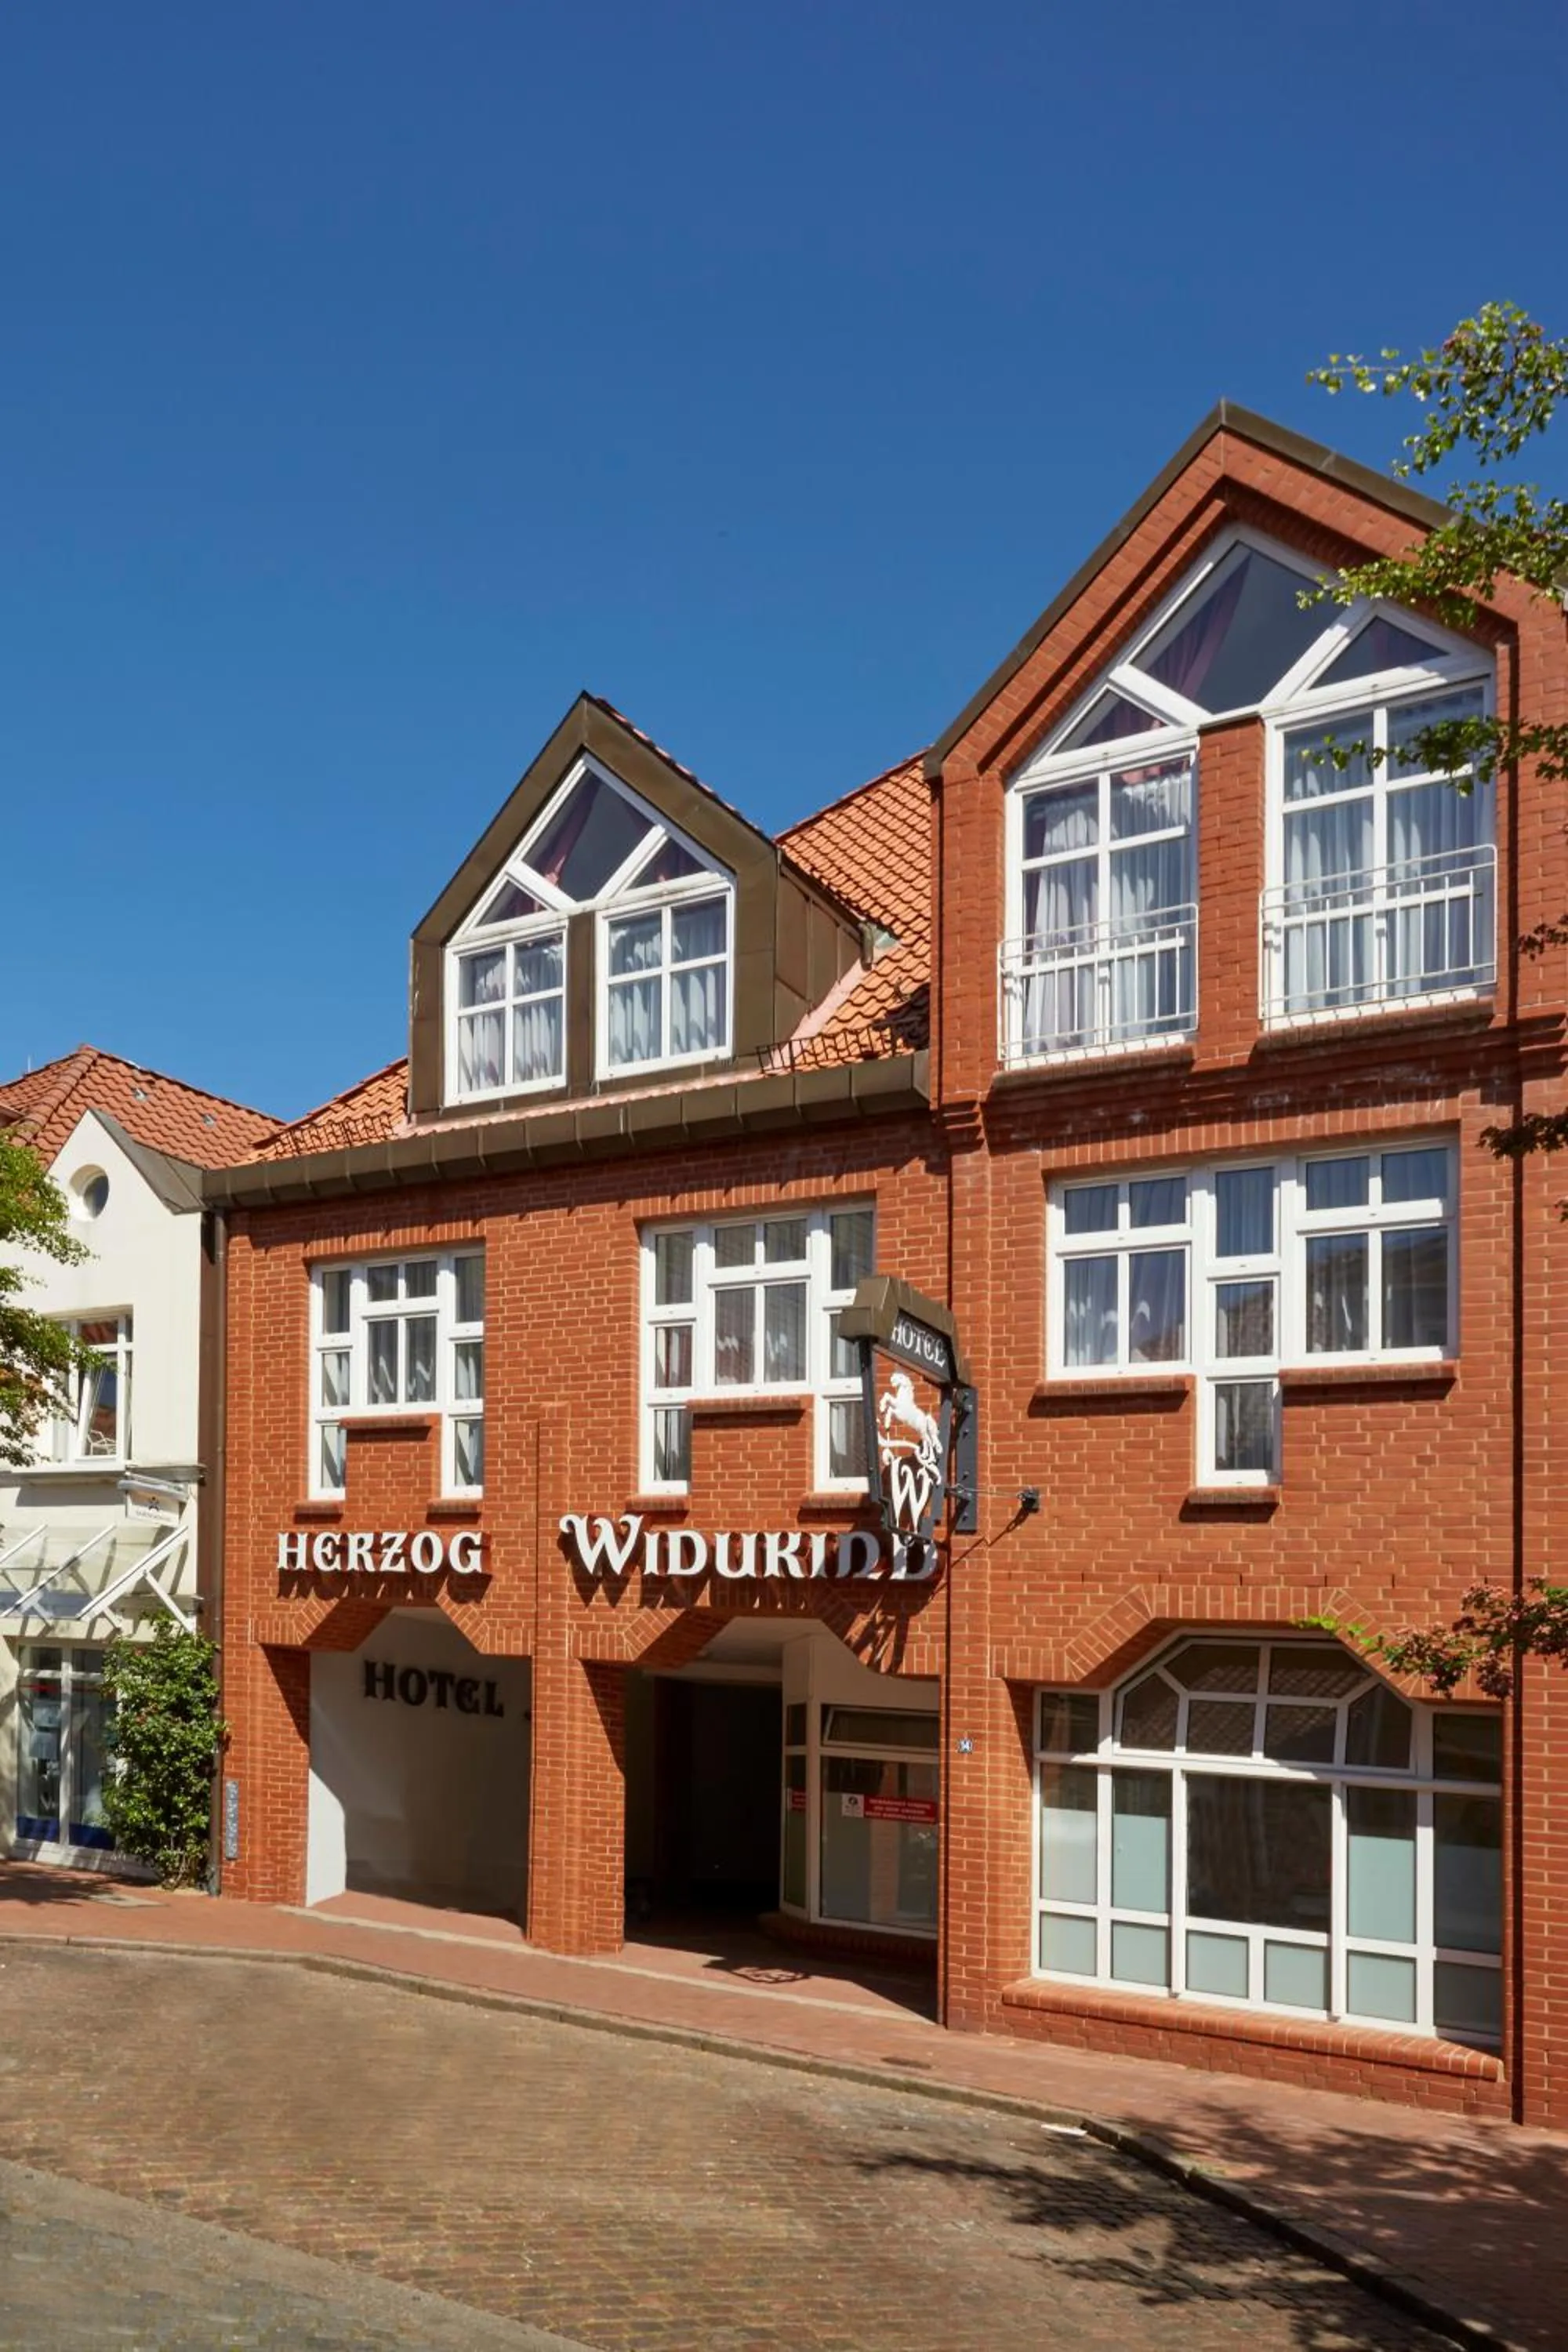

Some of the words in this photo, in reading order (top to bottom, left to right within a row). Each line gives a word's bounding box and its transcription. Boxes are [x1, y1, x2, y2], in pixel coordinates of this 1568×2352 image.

[890, 1319, 946, 1367] HOTEL
[277, 1530, 482, 1573] HERZOG
[559, 1513, 938, 1581] WIDUKIND
[364, 1659, 505, 1719] HOTEL
